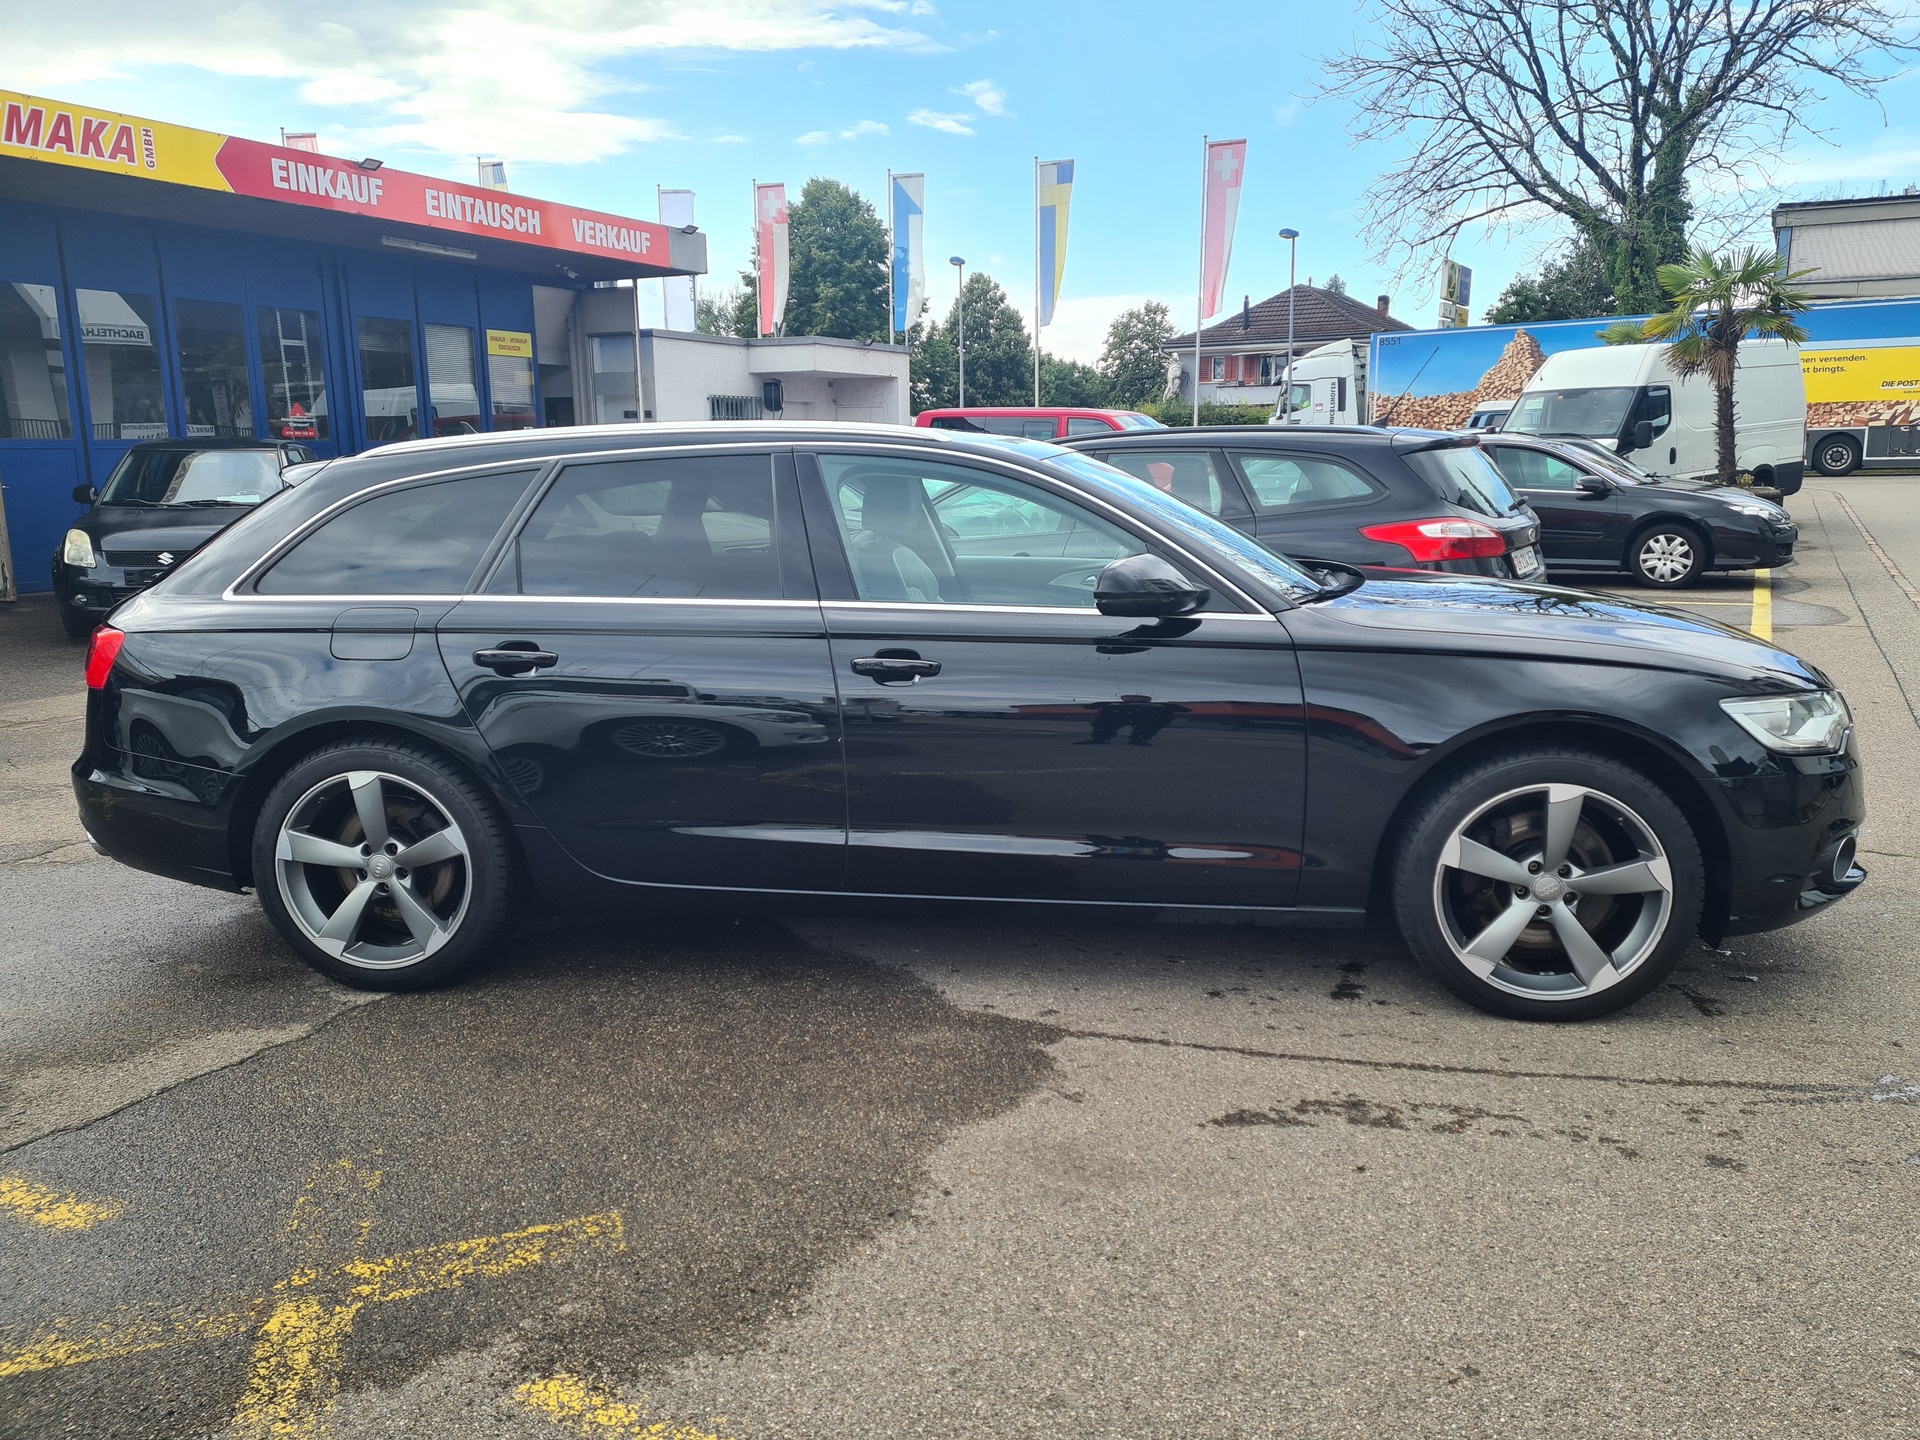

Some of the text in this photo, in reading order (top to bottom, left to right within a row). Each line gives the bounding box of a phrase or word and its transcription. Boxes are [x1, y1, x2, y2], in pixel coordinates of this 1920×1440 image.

[3, 103, 138, 167] MAKA
[143, 127, 155, 169] GMBH
[271, 157, 384, 205] EINKAUF
[425, 188, 541, 235] EINTAUSCH
[571, 217, 650, 254] VERKAUF
[1380, 337, 1400, 345] 8551
[1819, 354, 1868, 362] versenden.
[1813, 366, 1847, 374] bringts.
